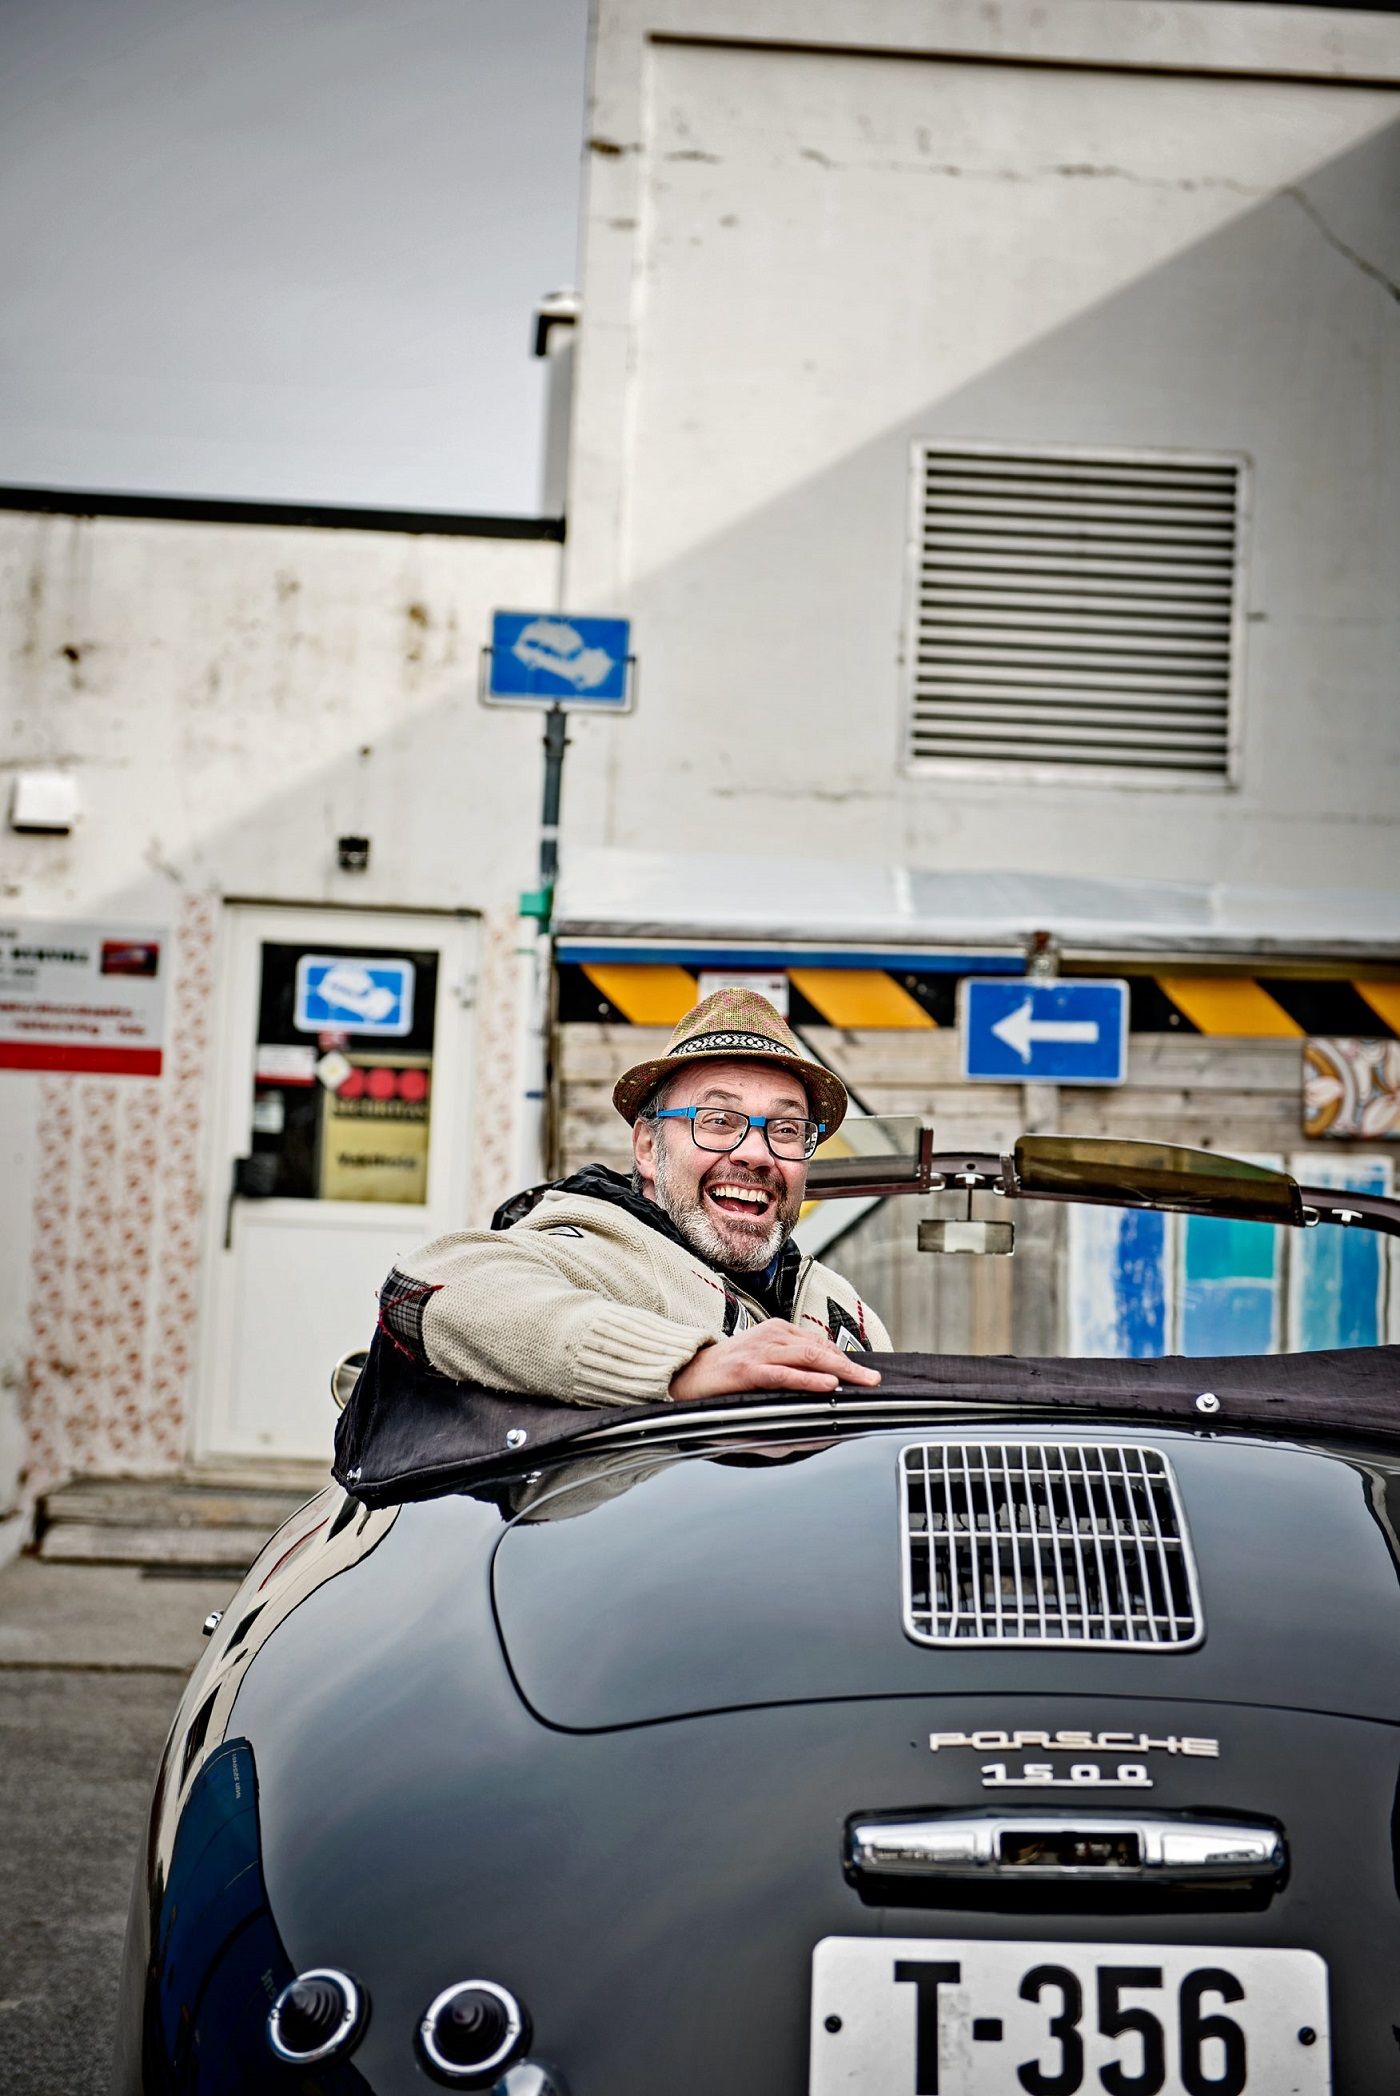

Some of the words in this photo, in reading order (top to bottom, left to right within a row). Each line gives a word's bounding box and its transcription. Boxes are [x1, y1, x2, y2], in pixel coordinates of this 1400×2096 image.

[929, 1731, 1219, 1758] PORSCHE
[981, 1763, 1153, 1787] 1500
[893, 1960, 1247, 2096] T-356
